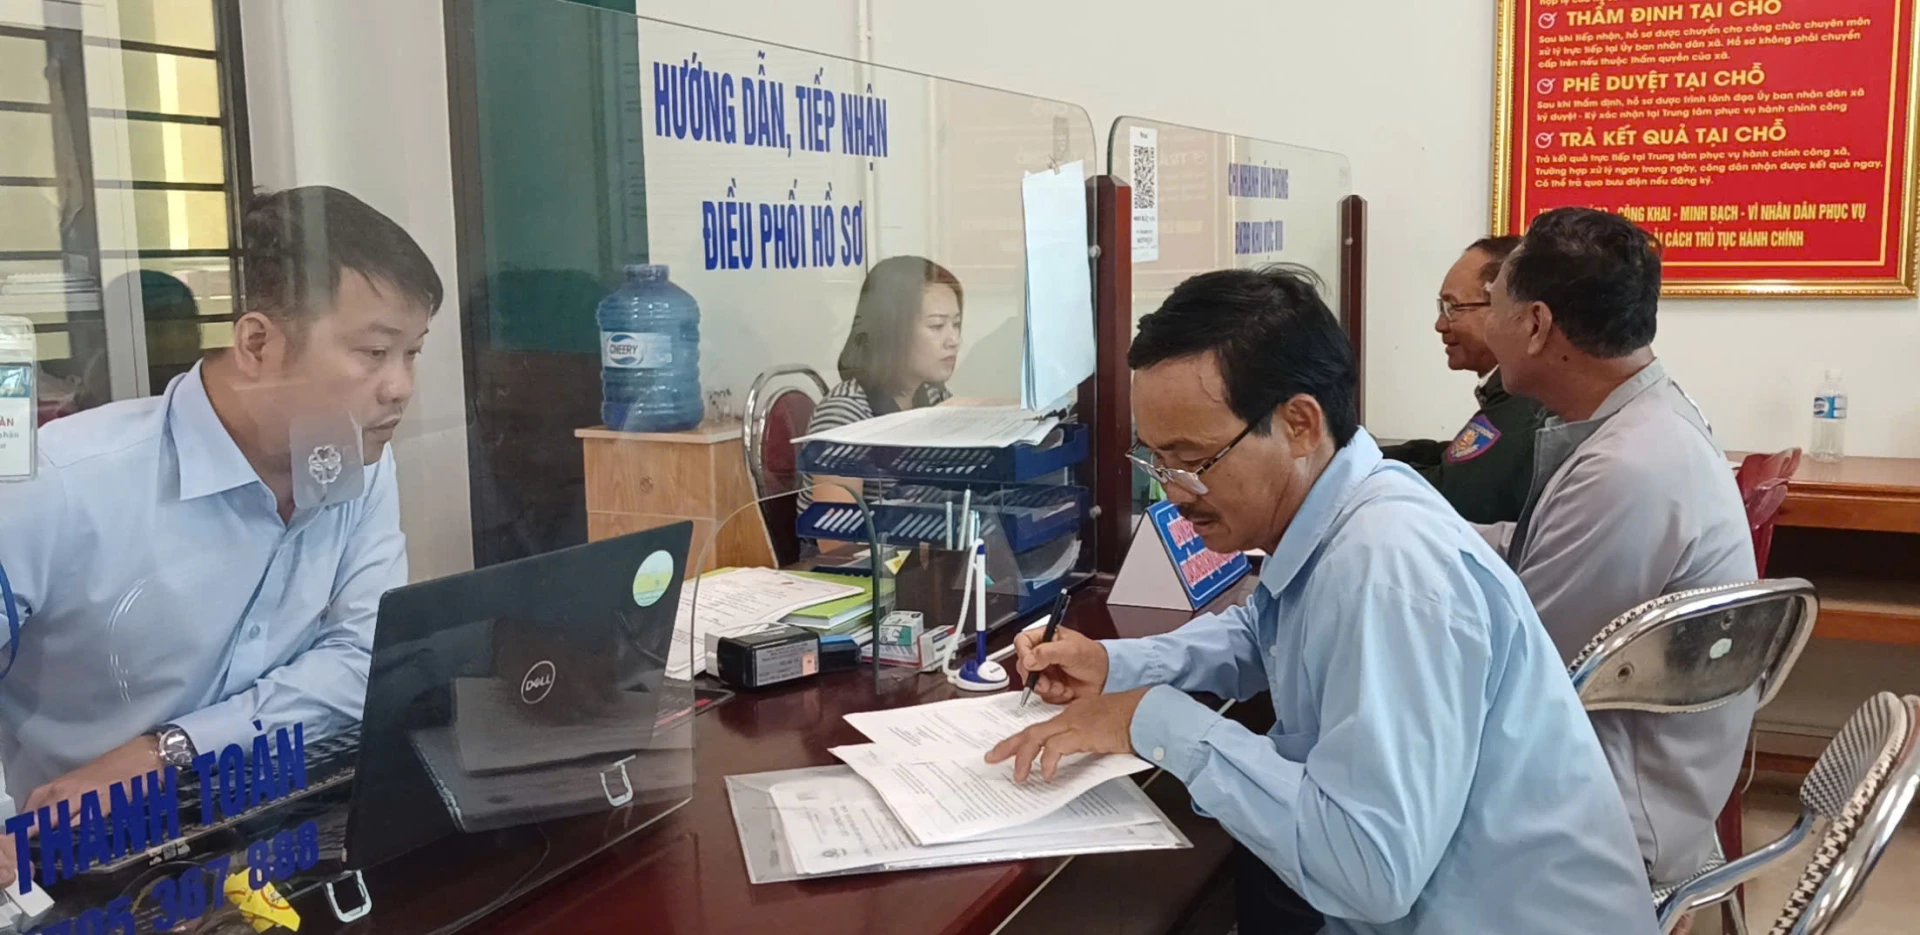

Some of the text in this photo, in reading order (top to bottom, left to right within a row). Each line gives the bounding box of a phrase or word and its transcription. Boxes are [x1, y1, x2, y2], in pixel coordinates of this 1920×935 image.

[1566, 4, 1624, 26] THẨM
[1631, 6, 1683, 26] ĐỊNH
[1690, 3, 1723, 22] TẠI
[1563, 62, 1765, 93] PHÊ DUYỆT TẠI CHỖ
[653, 50, 888, 171] HƯỚNG DẪN, TIẾP NHẬN
[1559, 118, 1786, 147] TRẢ KẾT QUẢ TẠI CHỖ
[702, 177, 863, 270] ĐIỀU PHỐI HỒ SƠ
[1647, 206, 1671, 221] KHAI
[1680, 206, 1708, 221] MINH
[1710, 205, 1738, 224] BẠCH
[1748, 202, 1758, 220] VÌ
[1760, 202, 1791, 220] NHÂN
[1793, 201, 1816, 220] DÂN
[1819, 203, 1848, 222] PHỤC
[1851, 203, 1866, 222] VỤ
[1665, 230, 1693, 247] CÁCH
[1695, 227, 1714, 247] THỦ
[1717, 231, 1737, 250] TỤC
[1739, 229, 1768, 247] HÀNH
[1771, 228, 1804, 247] CHÍNH
[610, 344, 638, 355] CHEERY
[526, 674, 550, 691] DELL
[5, 766, 180, 895] THANH
[247, 820, 318, 890] 888
